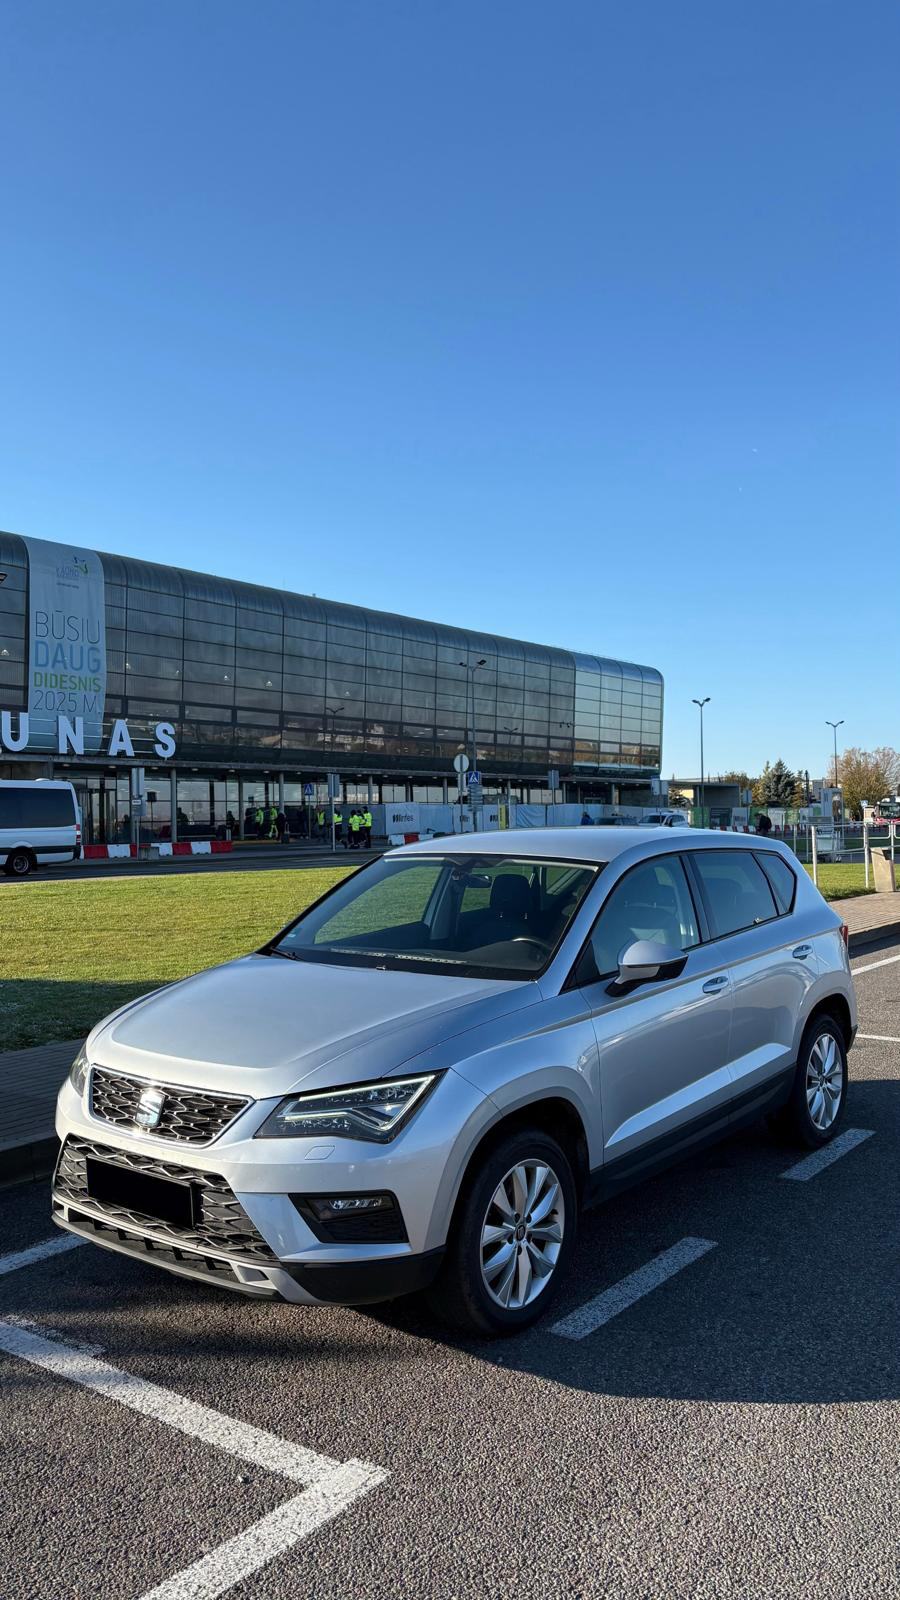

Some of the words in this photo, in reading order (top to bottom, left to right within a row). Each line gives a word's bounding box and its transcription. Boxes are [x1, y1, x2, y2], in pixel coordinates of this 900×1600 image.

[35, 610, 100, 645] BŪSIU
[34, 640, 101, 674] DAUG
[33, 671, 102, 693] DIDESNIS
[33, 690, 78, 713] 2025
